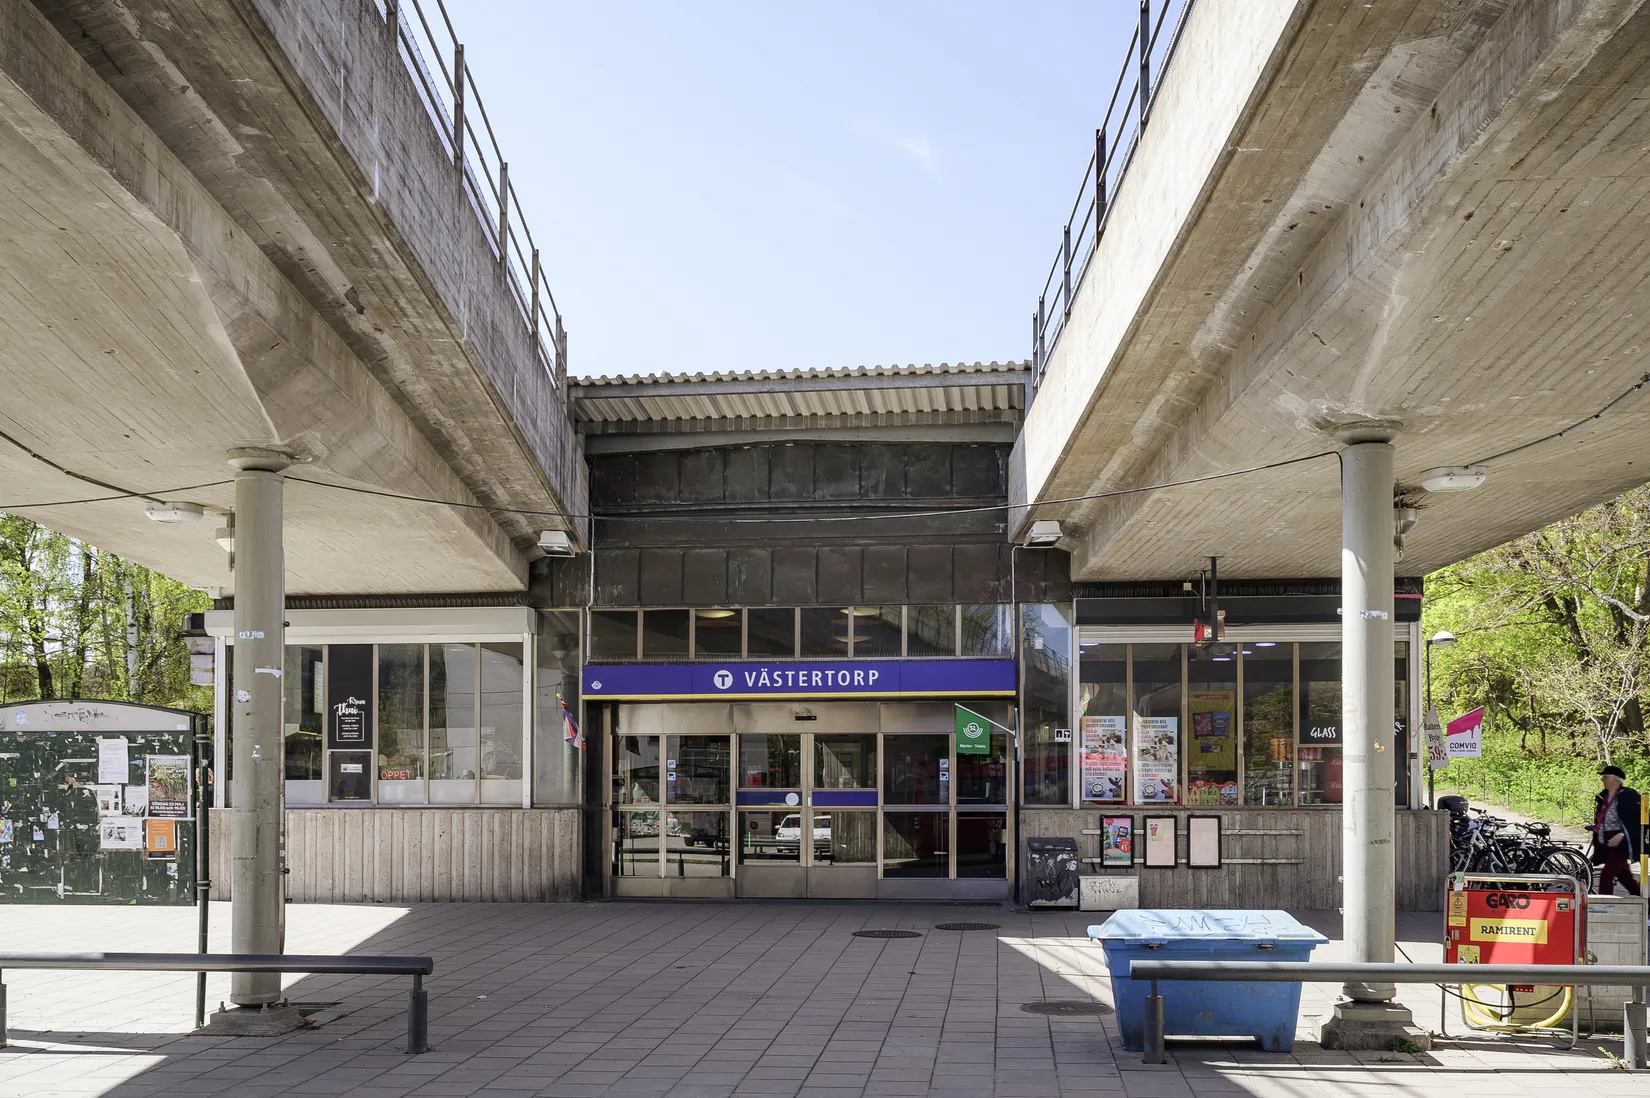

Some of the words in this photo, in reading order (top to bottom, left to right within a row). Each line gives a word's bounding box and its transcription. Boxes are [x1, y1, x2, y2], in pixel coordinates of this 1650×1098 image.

[744, 667, 880, 687] VÄSTERTORP
[1310, 726, 1336, 738] GLASS
[380, 769, 412, 780] ÖPPET
[1485, 892, 1531, 909] GARO
[1480, 925, 1537, 936] RAMIRENT
